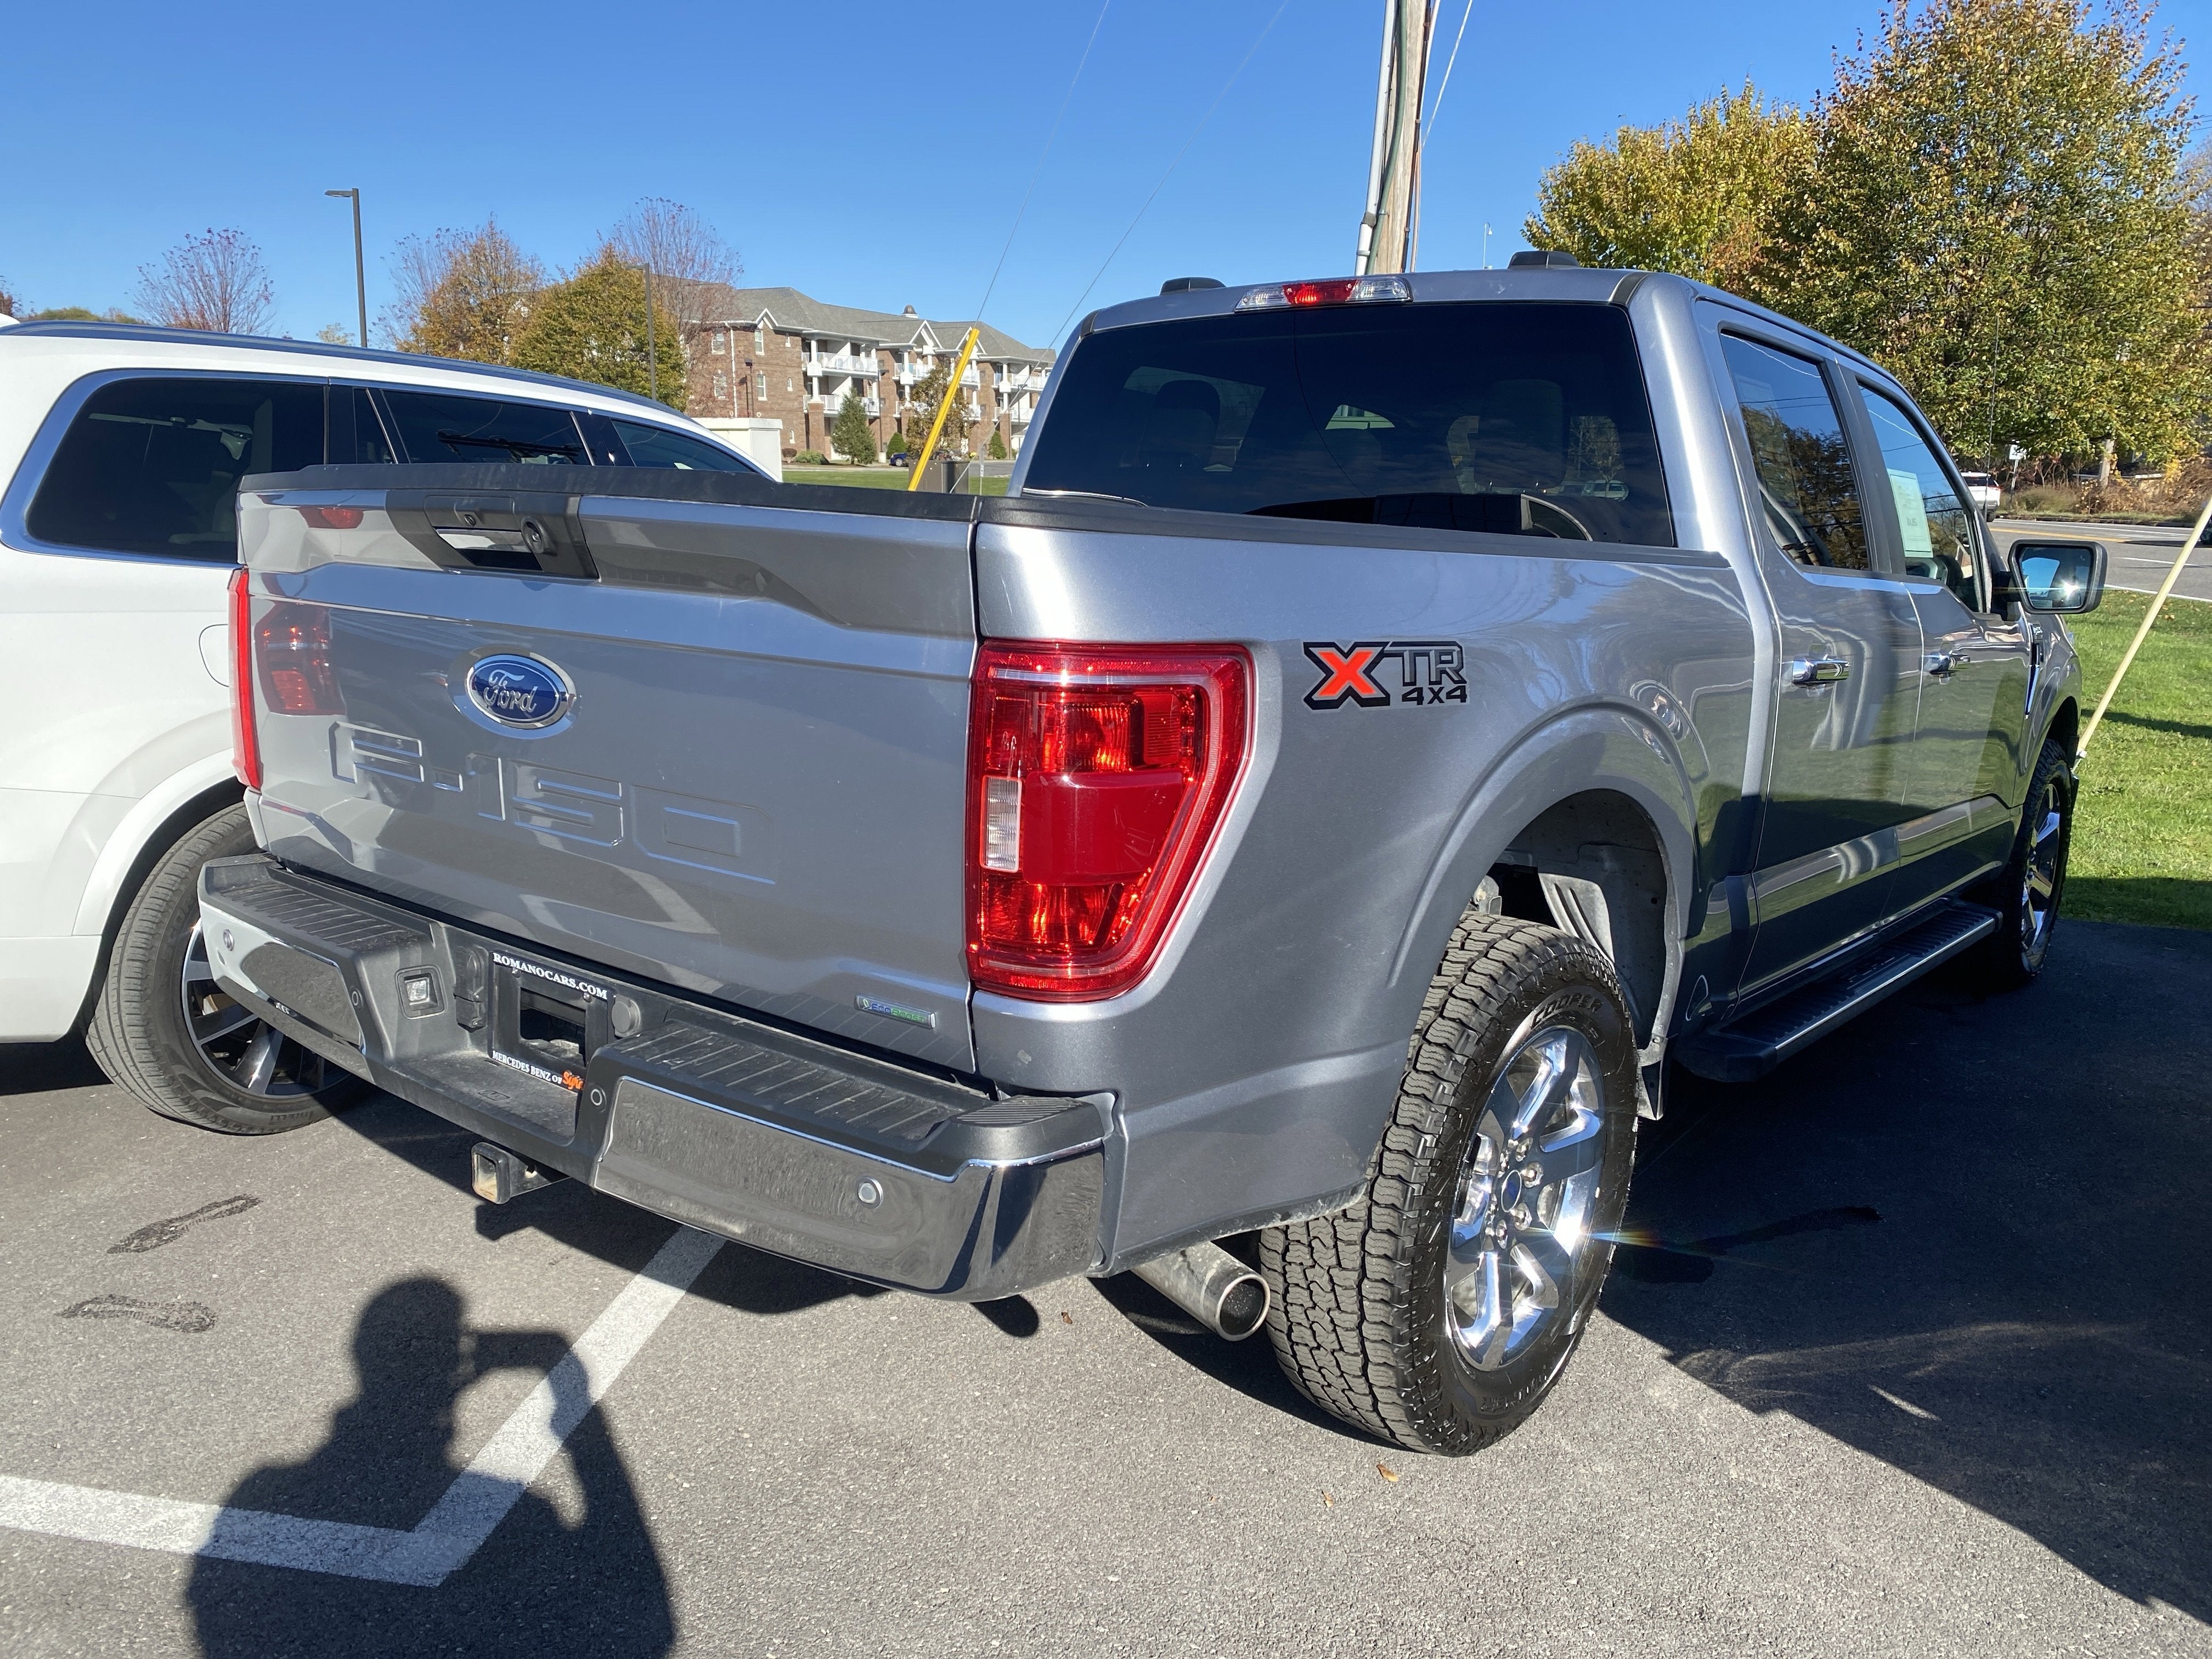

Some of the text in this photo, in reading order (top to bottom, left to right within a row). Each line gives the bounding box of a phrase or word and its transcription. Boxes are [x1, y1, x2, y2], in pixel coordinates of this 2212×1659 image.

[483, 669, 538, 713] Ford
[328, 721, 775, 884] F-150
[493, 952, 608, 1000] ROMANOCARS.COM
[492, 1050, 530, 1073] MERCEDES
[530, 1065, 551, 1082] BENZ
[551, 1075, 562, 1084] OF
